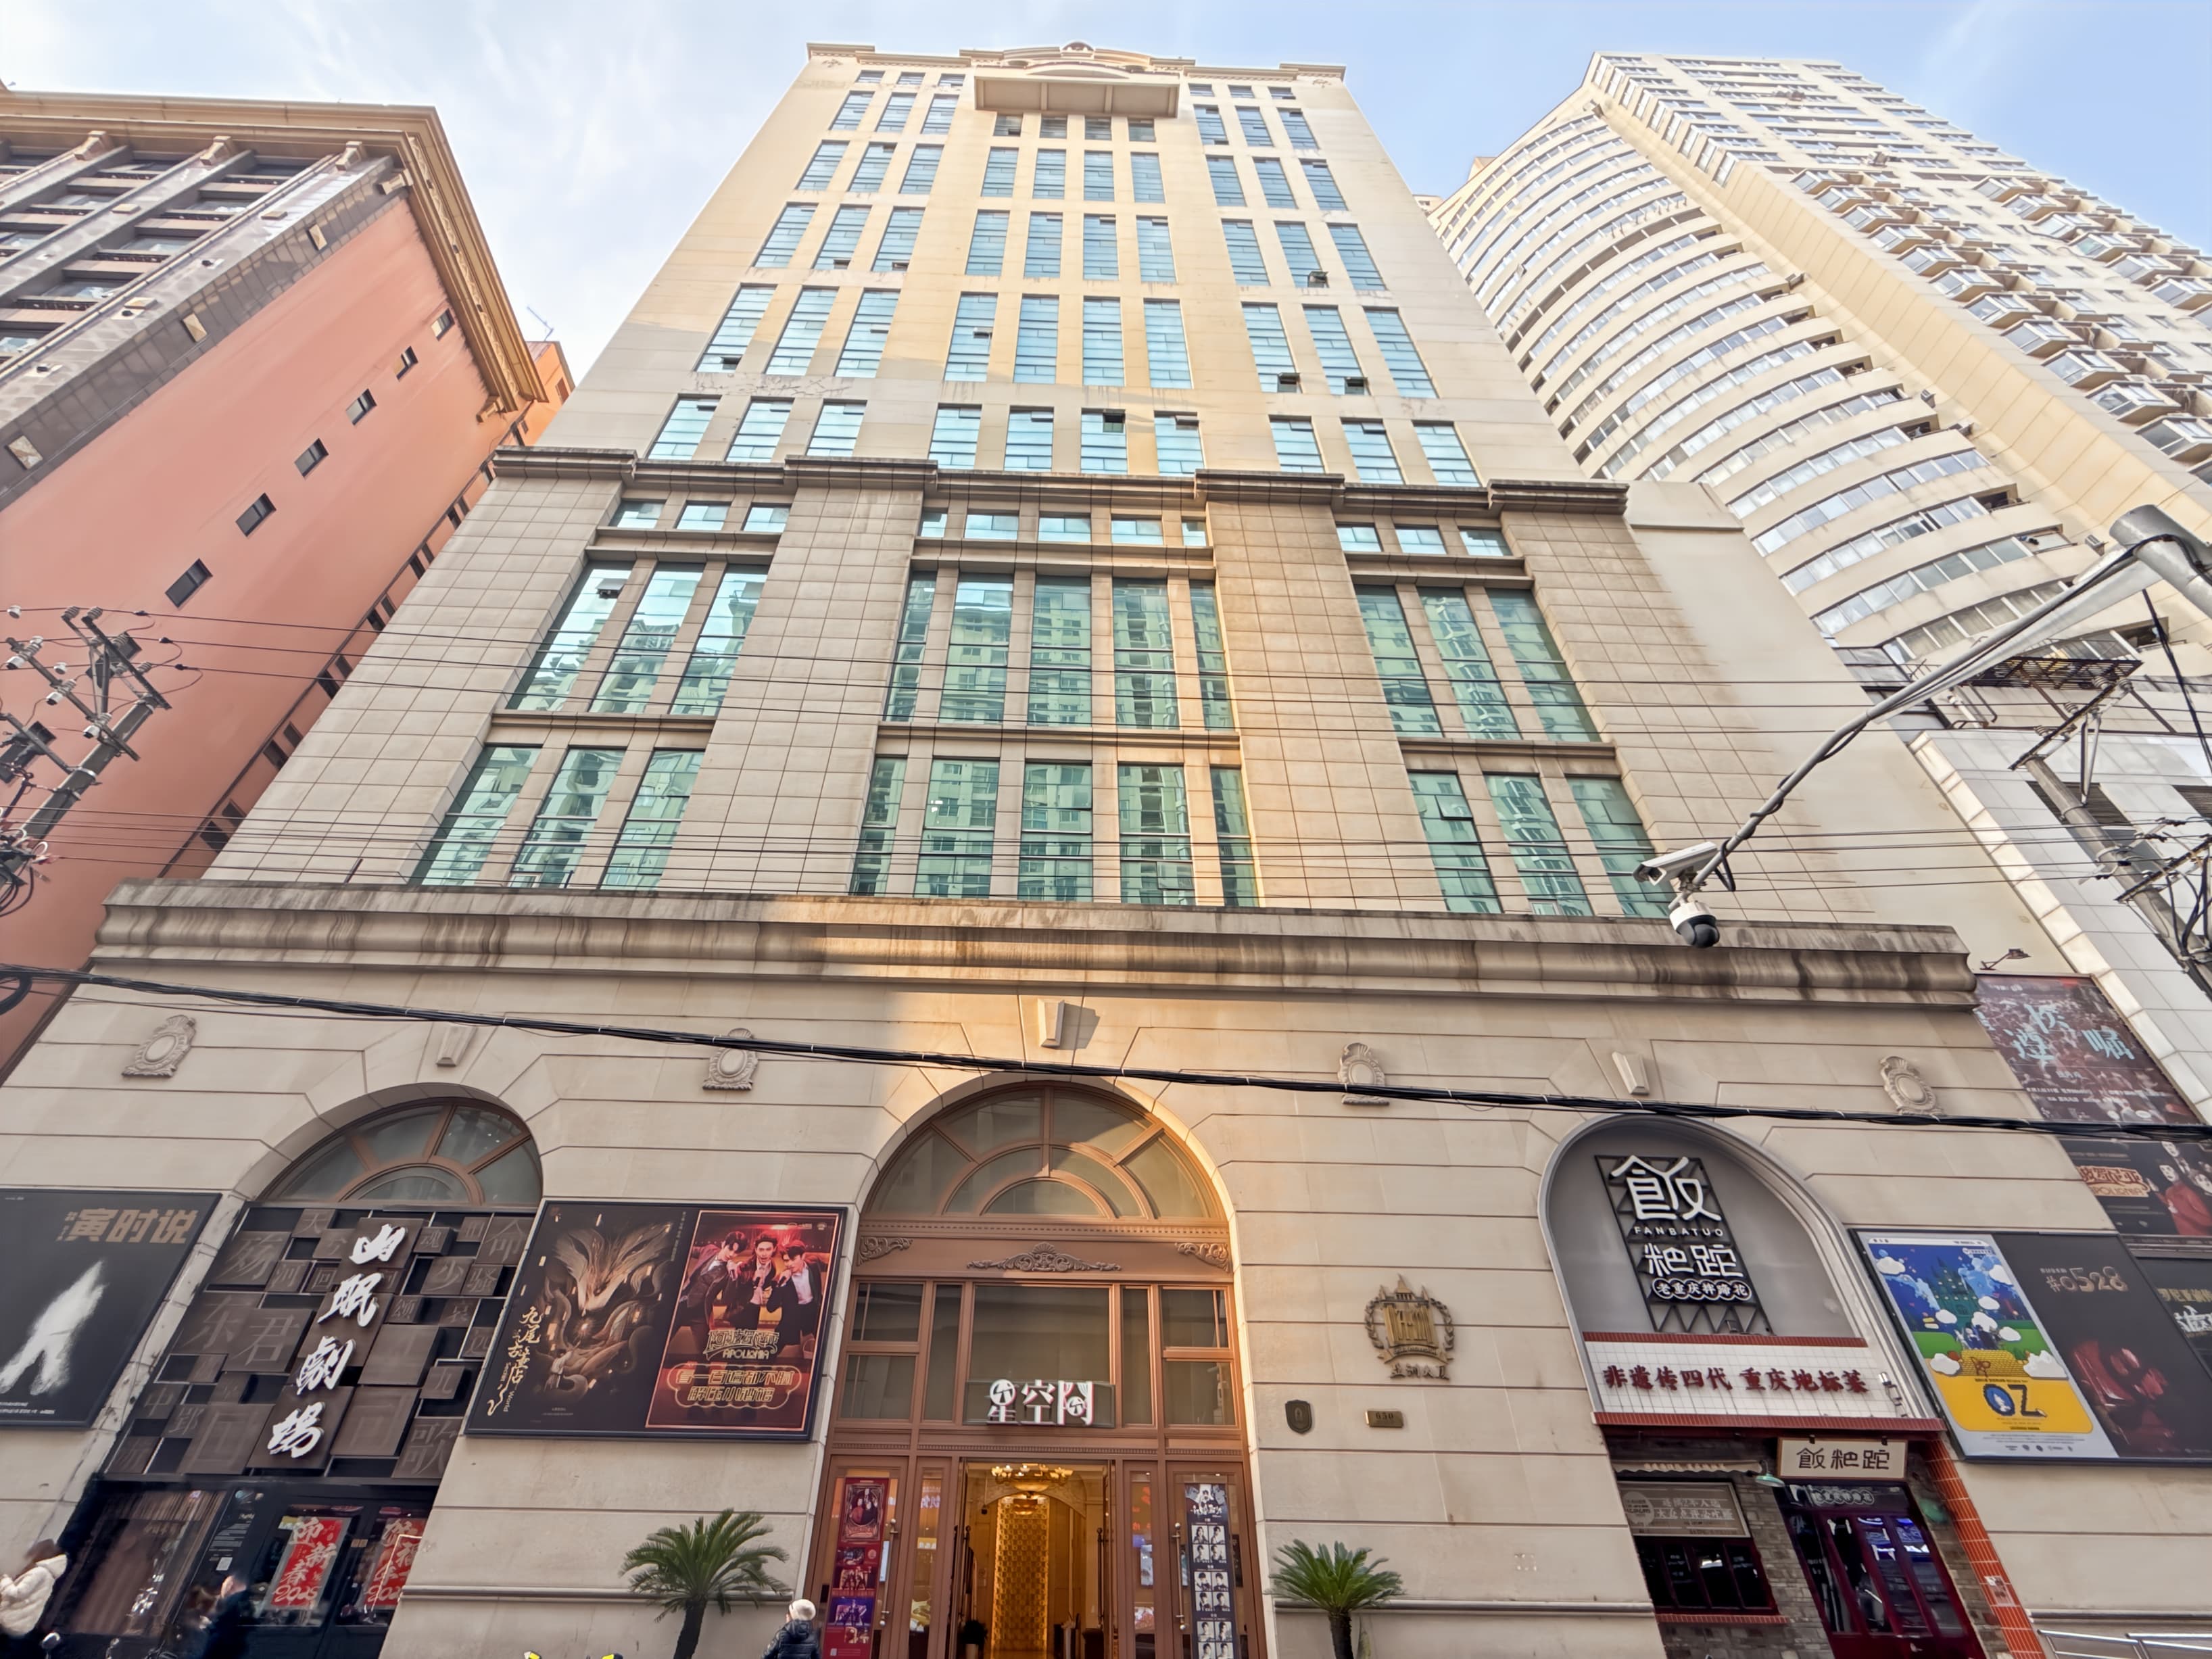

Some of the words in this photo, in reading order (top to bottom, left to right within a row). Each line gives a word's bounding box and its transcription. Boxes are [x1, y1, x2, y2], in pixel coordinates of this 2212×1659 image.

[66, 1208, 199, 1243] 寅时说
[485, 1220, 525, 1264] 命
[1634, 1226, 1724, 1237] FANBATUO
[425, 1259, 464, 1292] 少
[232, 1314, 300, 1366] 君
